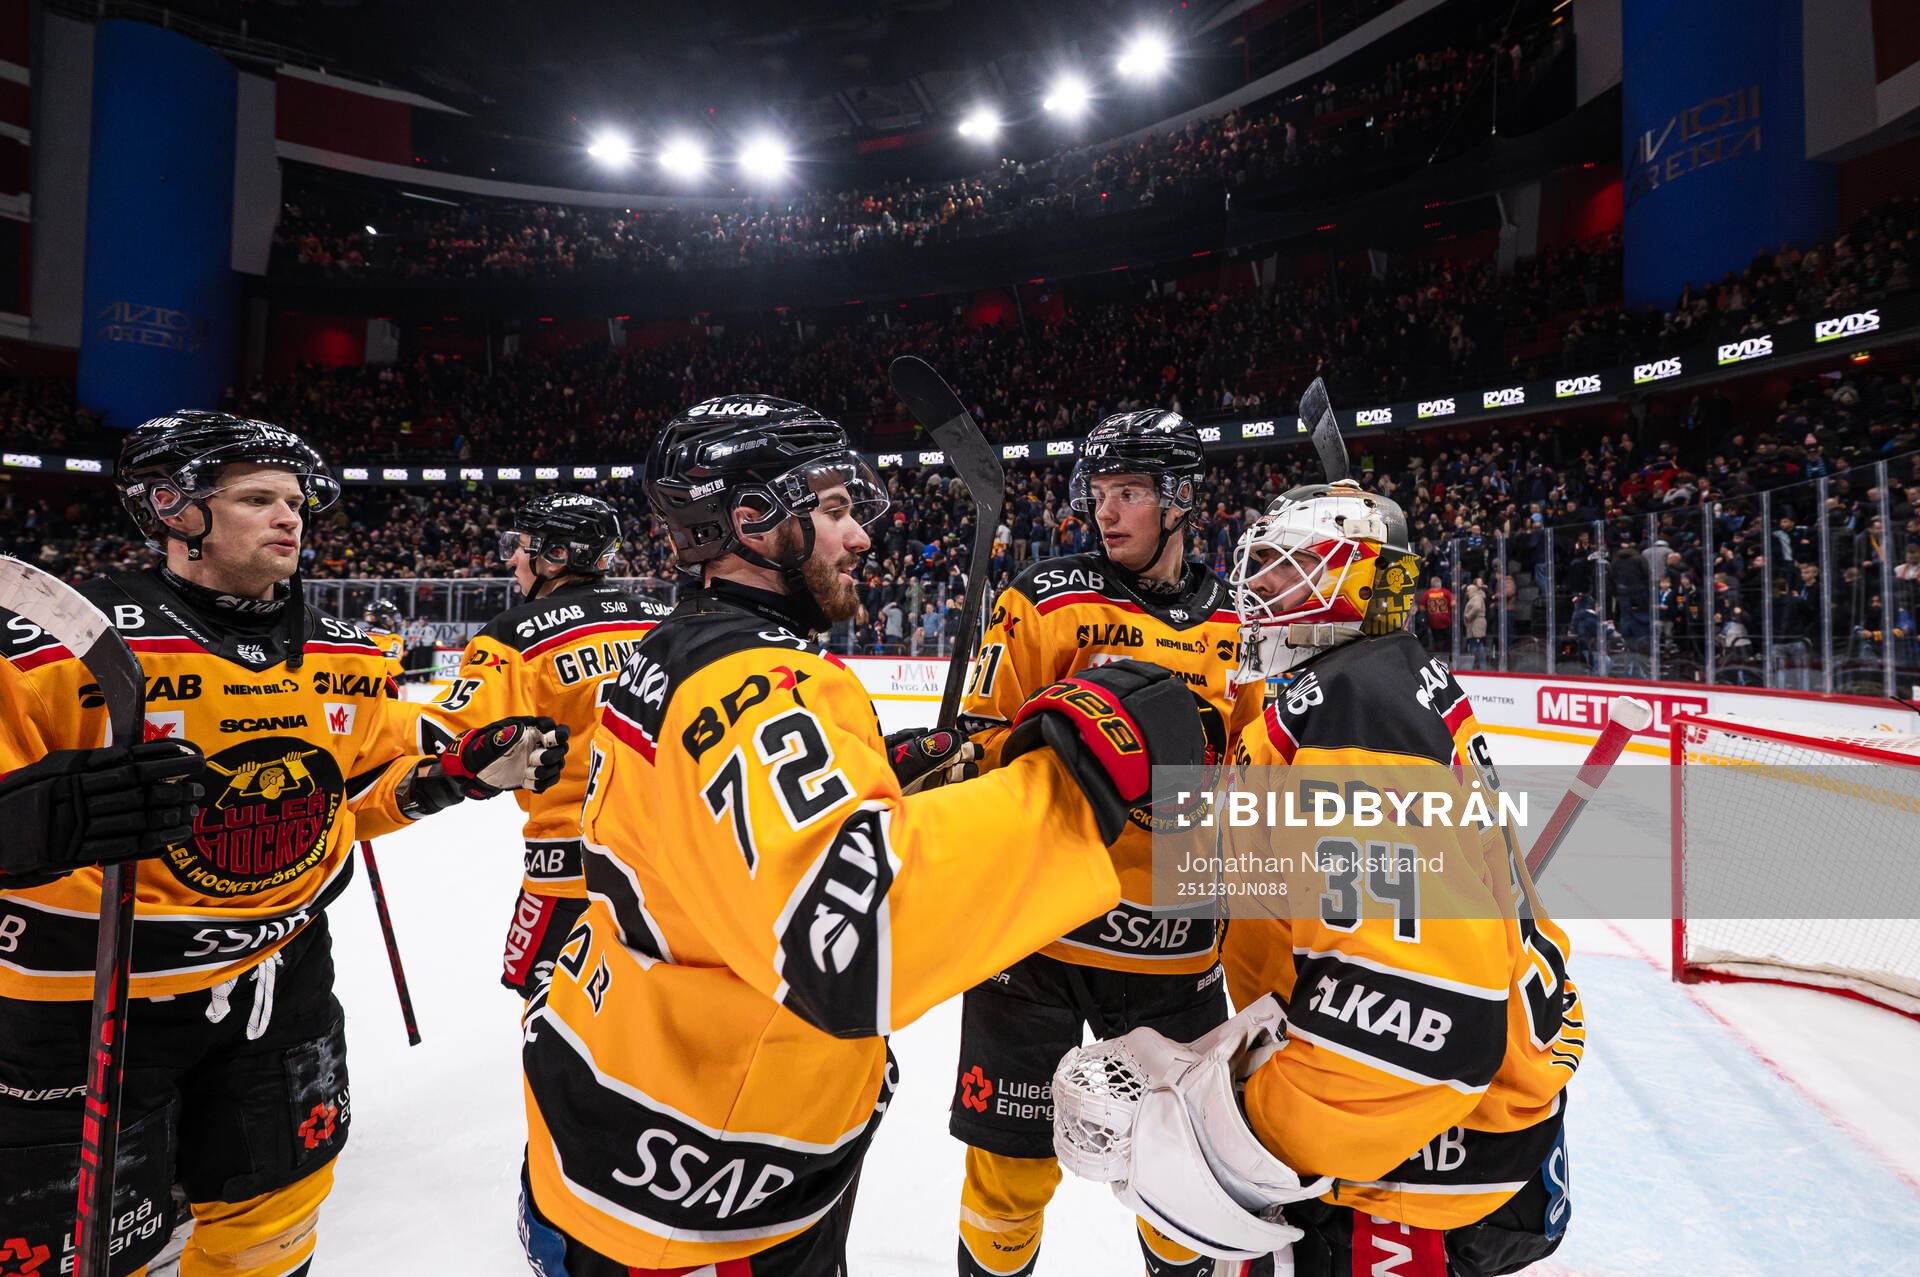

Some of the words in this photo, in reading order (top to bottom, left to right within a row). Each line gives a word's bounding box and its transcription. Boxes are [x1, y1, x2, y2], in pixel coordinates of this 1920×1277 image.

[1815, 309, 1880, 338] RYDS
[1718, 335, 1773, 360] RYDS
[1634, 357, 1682, 380] RYDS
[1483, 387, 1524, 406] RYDS
[1556, 375, 1601, 394] RYDS
[708, 402, 770, 416] LKAB
[1356, 408, 1392, 423] RYDS
[1417, 398, 1456, 415] RYDS
[1198, 427, 1221, 438] YDS
[1242, 422, 1274, 435] RYDS
[1085, 443, 1110, 460] kry
[562, 497, 594, 507] LKAB
[1033, 568, 1104, 595] SSAB
[533, 604, 585, 632] LKAB
[600, 602, 628, 614] SSAB
[321, 617, 374, 642] SSA
[1092, 624, 1144, 649] LKAB
[1156, 638, 1181, 651] NIEMI
[891, 663, 938, 681] JMW
[143, 673, 202, 702] AB
[224, 684, 262, 695] NIEMI
[920, 683, 939, 692] AB
[1482, 695, 1515, 705] MATTERS
[219, 714, 308, 733] SCANIA
[699, 706, 858, 881] 72
[193, 787, 326, 834] LULEÅ
[166, 842, 198, 870] LEÅ
[193, 814, 325, 876] HOCKEY
[523, 848, 566, 874] SAB
[1314, 836, 1421, 944] 34
[1100, 910, 1192, 949] SSAB
[1317, 978, 1453, 1053] LKAB
[996, 1098, 1056, 1121] Energ
[611, 1127, 795, 1219] SSAB
[62, 1198, 153, 1253] Lleå
[60, 1212, 164, 1275] Eergi
